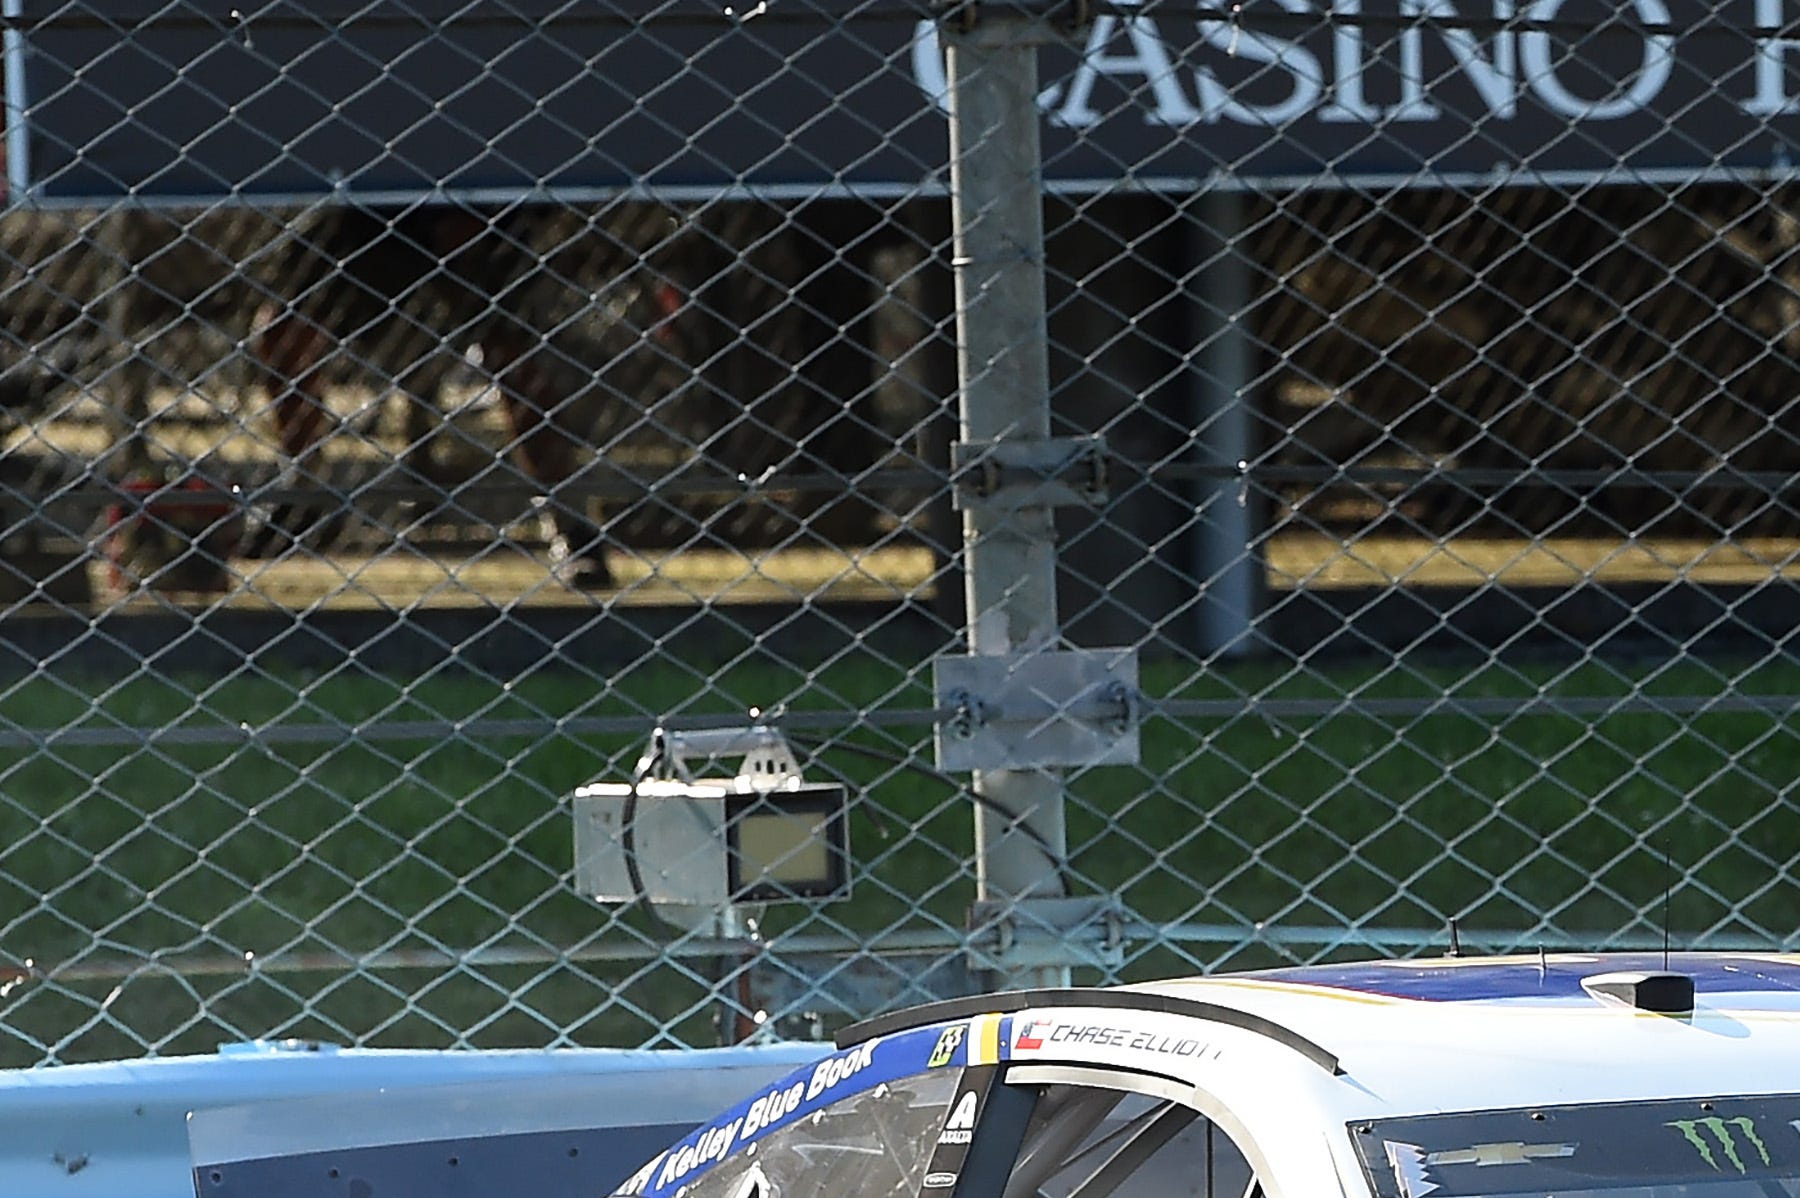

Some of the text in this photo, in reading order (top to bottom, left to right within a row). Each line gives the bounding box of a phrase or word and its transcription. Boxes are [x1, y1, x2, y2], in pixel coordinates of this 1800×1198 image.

[1050, 1024, 1132, 1047] CHASE
[655, 1117, 744, 1191] Kelley
[740, 1081, 806, 1141] Blue
[805, 1037, 882, 1102] Book
